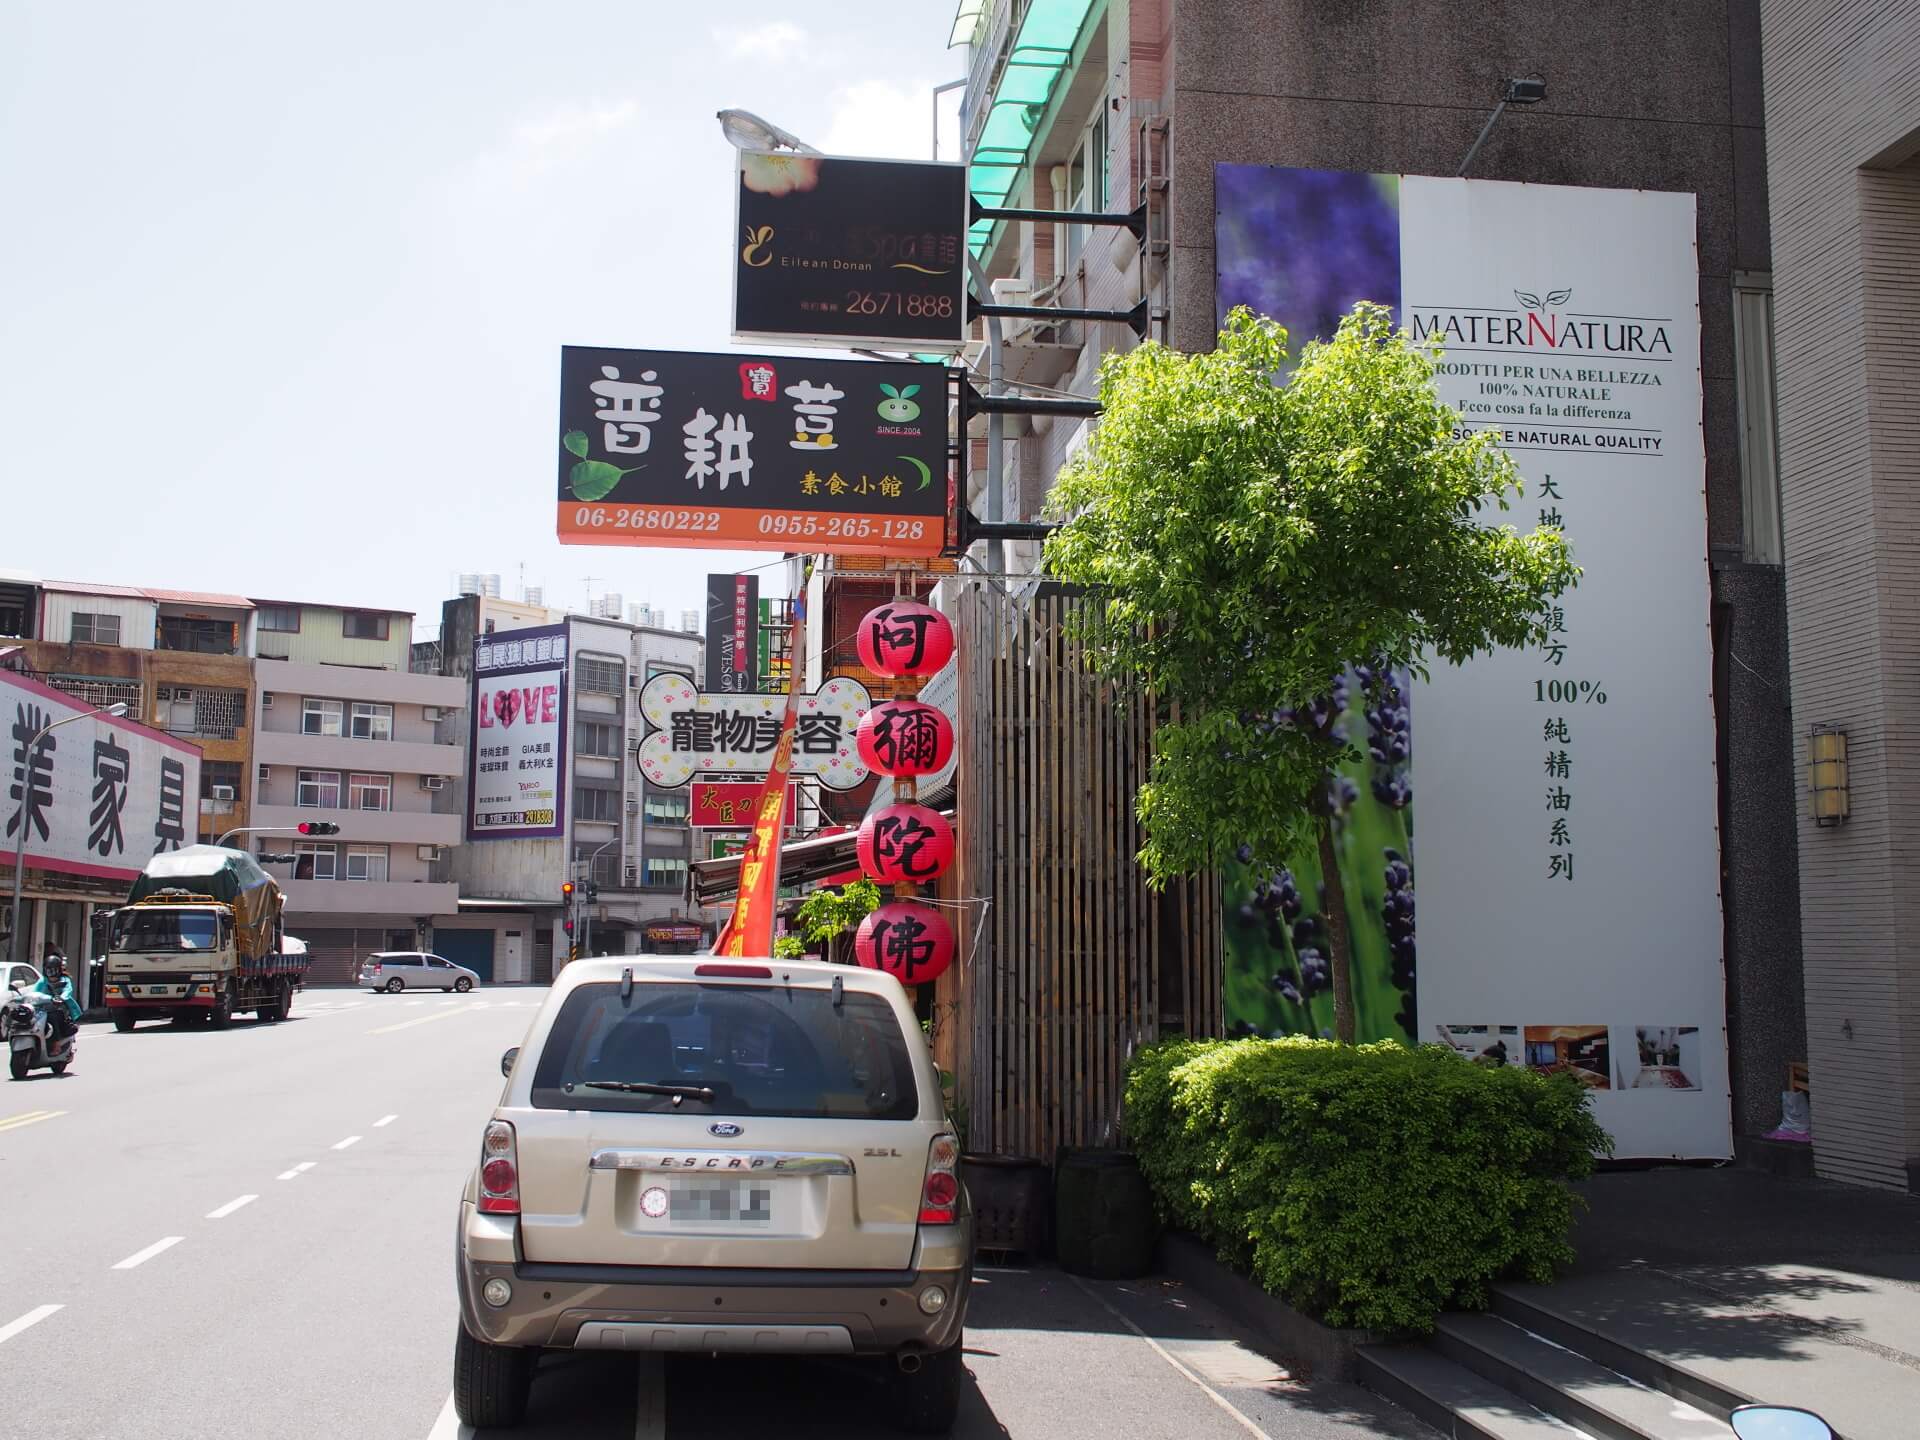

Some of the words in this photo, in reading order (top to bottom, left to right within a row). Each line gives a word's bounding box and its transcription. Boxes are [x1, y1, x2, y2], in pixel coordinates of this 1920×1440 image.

[781, 256, 828, 269] Eilean
[833, 259, 872, 272] Donan
[846, 290, 952, 318] 2671888
[1412, 312, 1672, 353] MATERNATURA
[1432, 362, 1498, 377] RODTTI
[1503, 365, 1535, 379] PER
[1540, 368, 1573, 382] UNA
[1577, 370, 1662, 386] BELLEZZA
[1480, 382, 1518, 396] 100%
[1523, 385, 1611, 401] NATURALE
[1458, 399, 1491, 413] Ecco
[1495, 404, 1525, 415] cosa
[1529, 403, 1542, 416] fa
[1546, 404, 1559, 416] la
[1562, 404, 1632, 421] differenza
[877, 426, 901, 434] SINCE
[1518, 431, 1592, 446] NATURAL
[1595, 434, 1662, 450] QUALITY
[799, 470, 903, 497] 素食小館
[575, 508, 721, 532] 06-2680222
[758, 515, 924, 539] 0955-265-128
[1532, 679, 1607, 705] 100%
[479, 685, 557, 730] LOVE
[6, 701, 184, 856] 業家具
[1543, 717, 1574, 881] 純精油系列
[714, 1124, 737, 1135] Ford
[660, 1156, 788, 1170] ESCAPE
